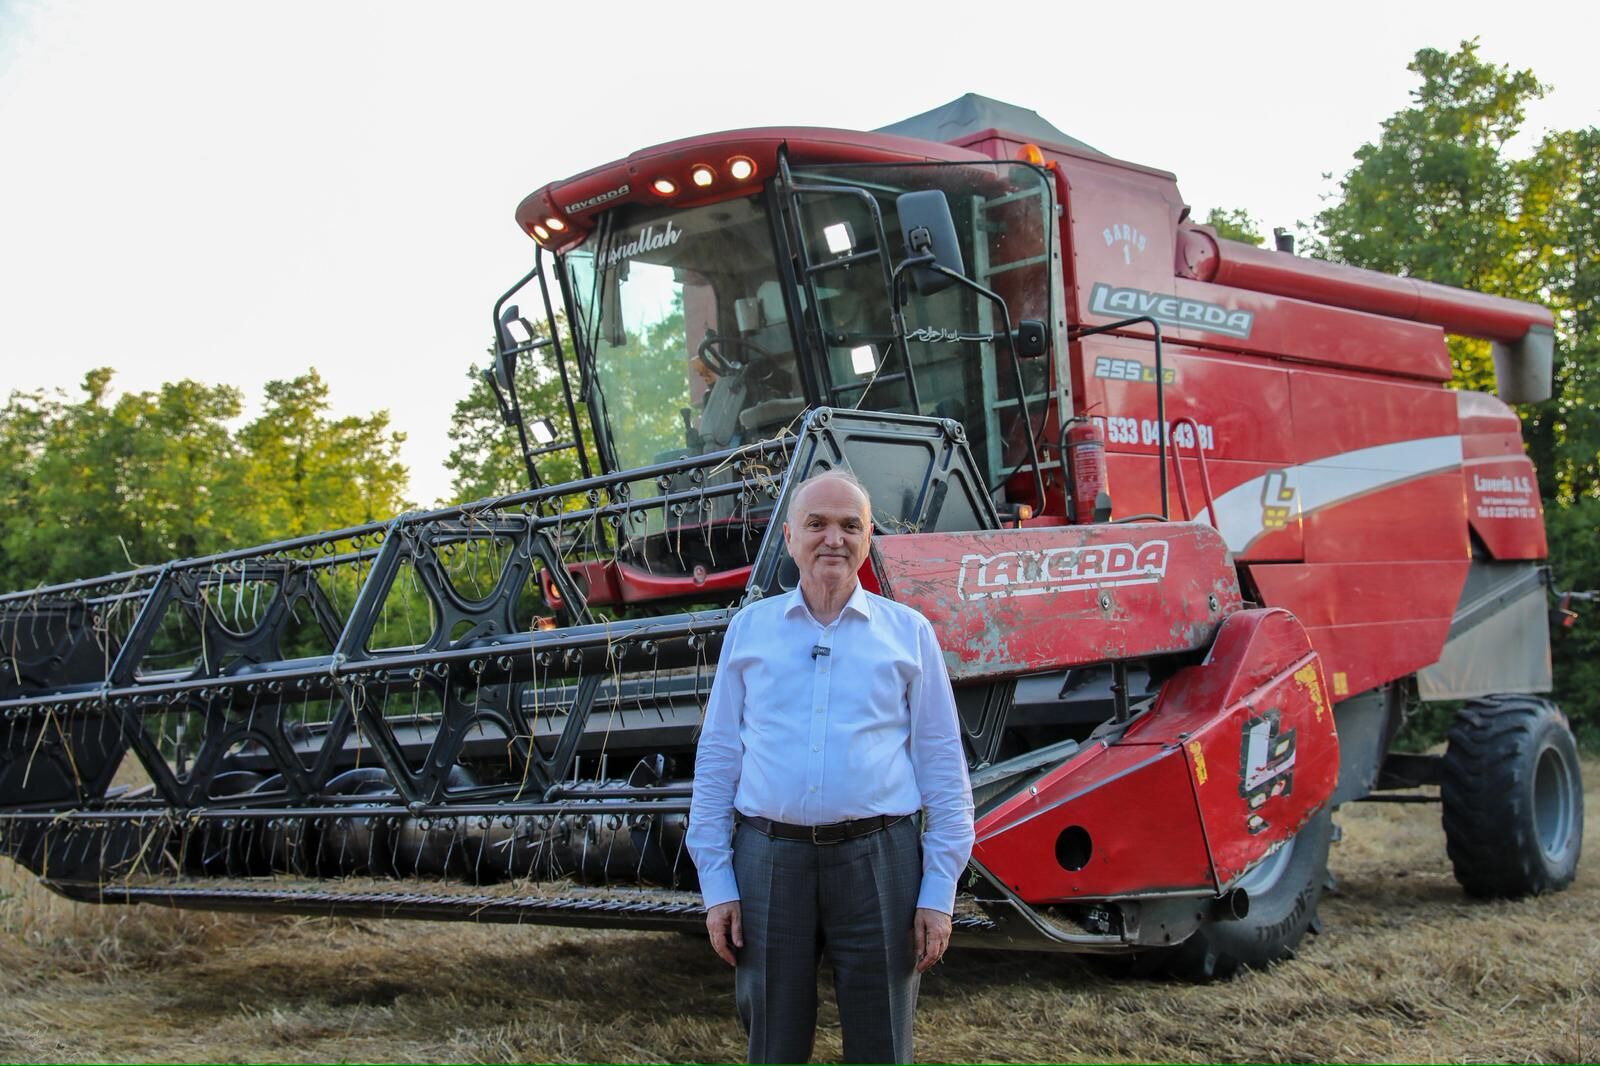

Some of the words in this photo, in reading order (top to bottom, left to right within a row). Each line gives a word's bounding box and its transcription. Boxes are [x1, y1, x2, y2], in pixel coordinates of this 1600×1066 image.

[564, 184, 630, 214] LAVERDA
[1092, 286, 1251, 336] LAVERDA
[1095, 358, 1141, 381] 255
[1107, 416, 1139, 445] 533
[1174, 421, 1195, 448] 43
[957, 540, 1169, 600] LAVERDA
